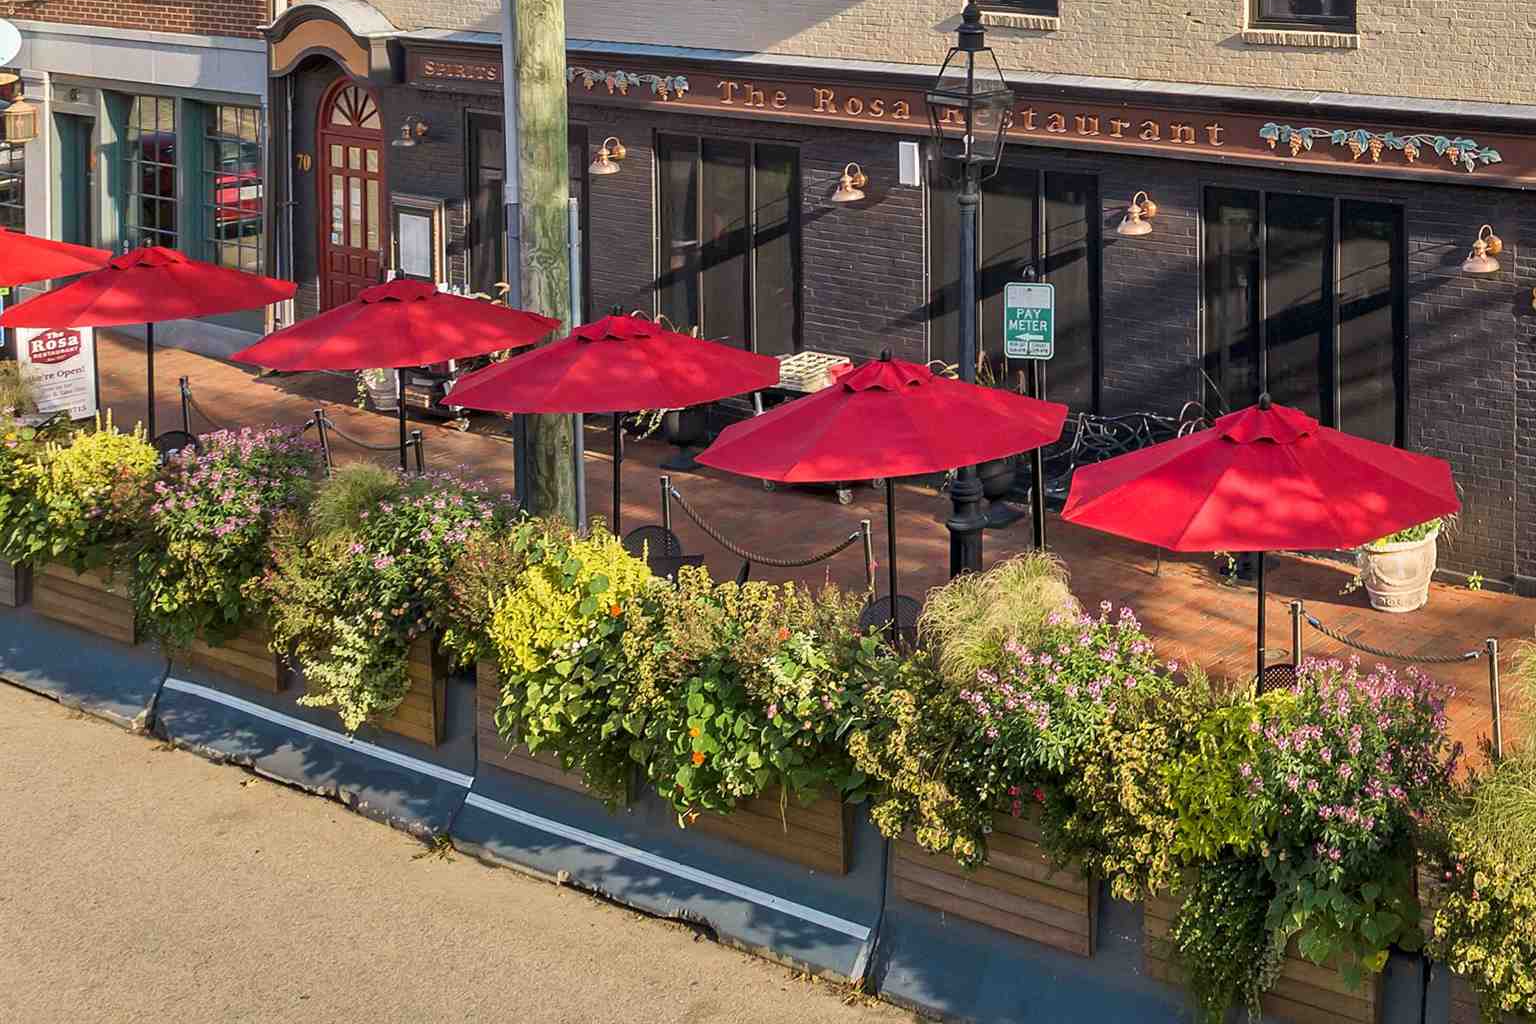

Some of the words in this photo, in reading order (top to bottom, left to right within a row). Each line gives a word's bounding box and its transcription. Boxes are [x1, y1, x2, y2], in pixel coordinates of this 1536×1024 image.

[424, 60, 497, 80] SPIRITS
[717, 79, 788, 109] The
[812, 87, 911, 120] Rosa
[296, 153, 312, 172] 70
[1016, 308, 1041, 319] PAY
[1008, 319, 1048, 332] METER
[31, 335, 79, 353] Rosa
